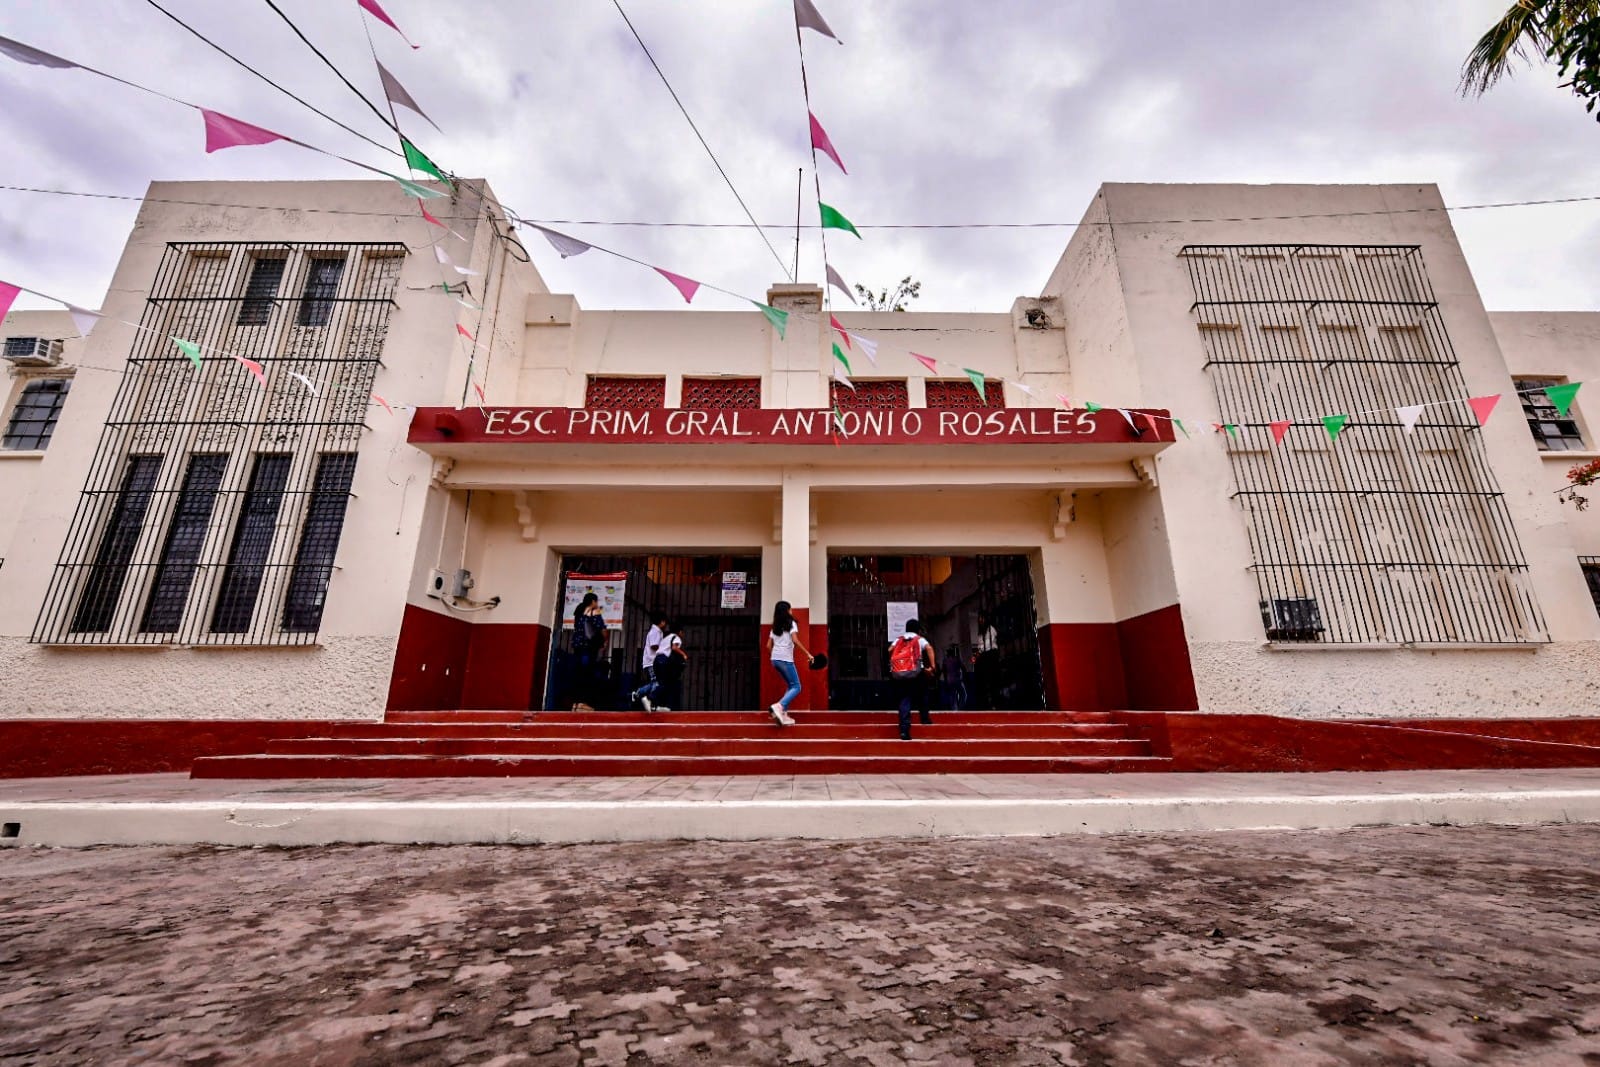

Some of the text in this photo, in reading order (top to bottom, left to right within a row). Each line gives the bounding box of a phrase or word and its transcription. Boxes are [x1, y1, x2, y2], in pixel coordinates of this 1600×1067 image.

[484, 409, 1097, 436] ESC. PRIM. GRAL. ANTONIO ROSALES
